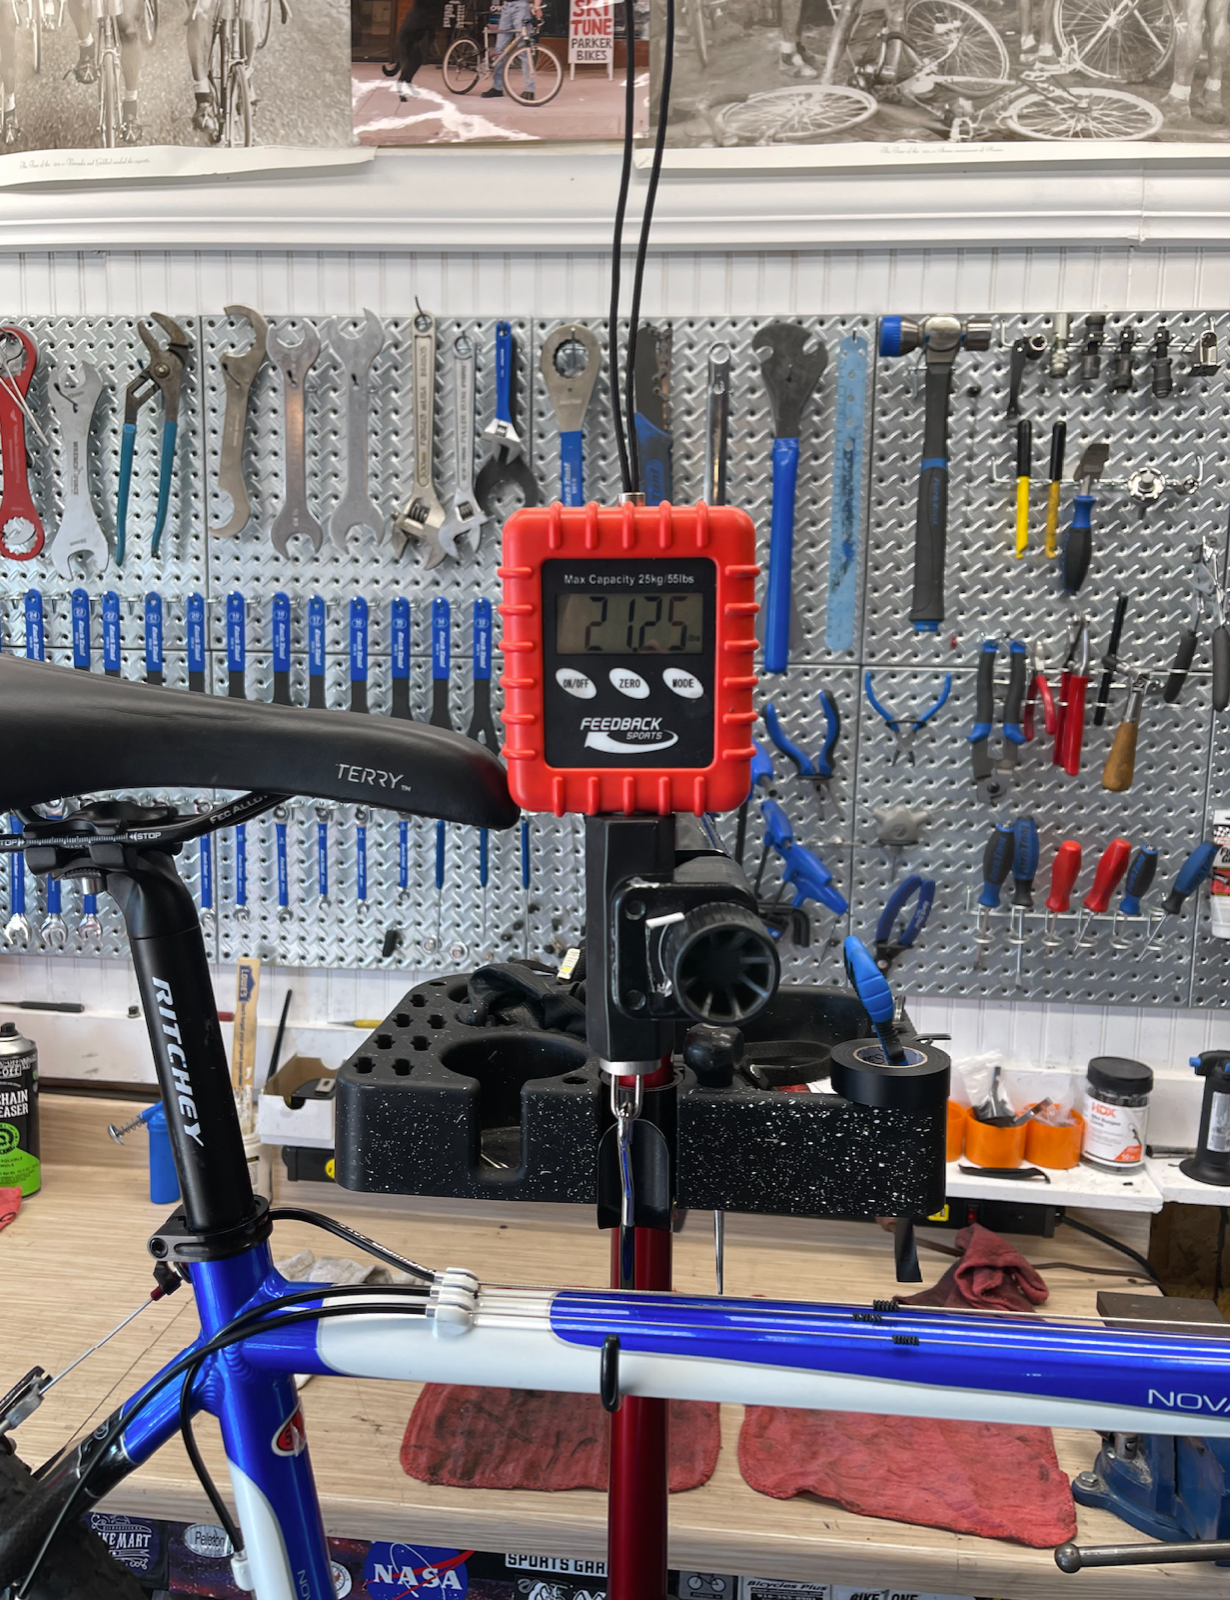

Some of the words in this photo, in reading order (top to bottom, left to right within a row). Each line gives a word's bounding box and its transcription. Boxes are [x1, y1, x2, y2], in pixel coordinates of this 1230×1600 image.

[571, 18, 612, 36] TUNE
[571, 38, 613, 49] PARKER
[576, 50, 608, 61] BIKES
[564, 574, 586, 584] Max
[588, 573, 636, 587] Capacity
[638, 573, 695, 587] 25kg/55lbs
[584, 596, 688, 653] 21.25
[563, 678, 589, 689] ON/OFF
[619, 678, 641, 689] ZERO
[672, 678, 695, 689] MODE
[580, 717, 663, 731] FEEDBACK
[625, 732, 663, 740] SPORTS
[337, 763, 404, 789] TERRY
[136, 832, 162, 841] STOP
[152, 976, 204, 1147] RITCHEY
[0, 1089, 28, 1106] HAIN
[1091, 1102, 1117, 1118] HDX
[115, 1532, 152, 1549] MART
[508, 1553, 569, 1571] SPORTS
[373, 1563, 463, 1590] NASA
[747, 1580, 798, 1589] Bicycles
[800, 1583, 828, 1591] Plus
